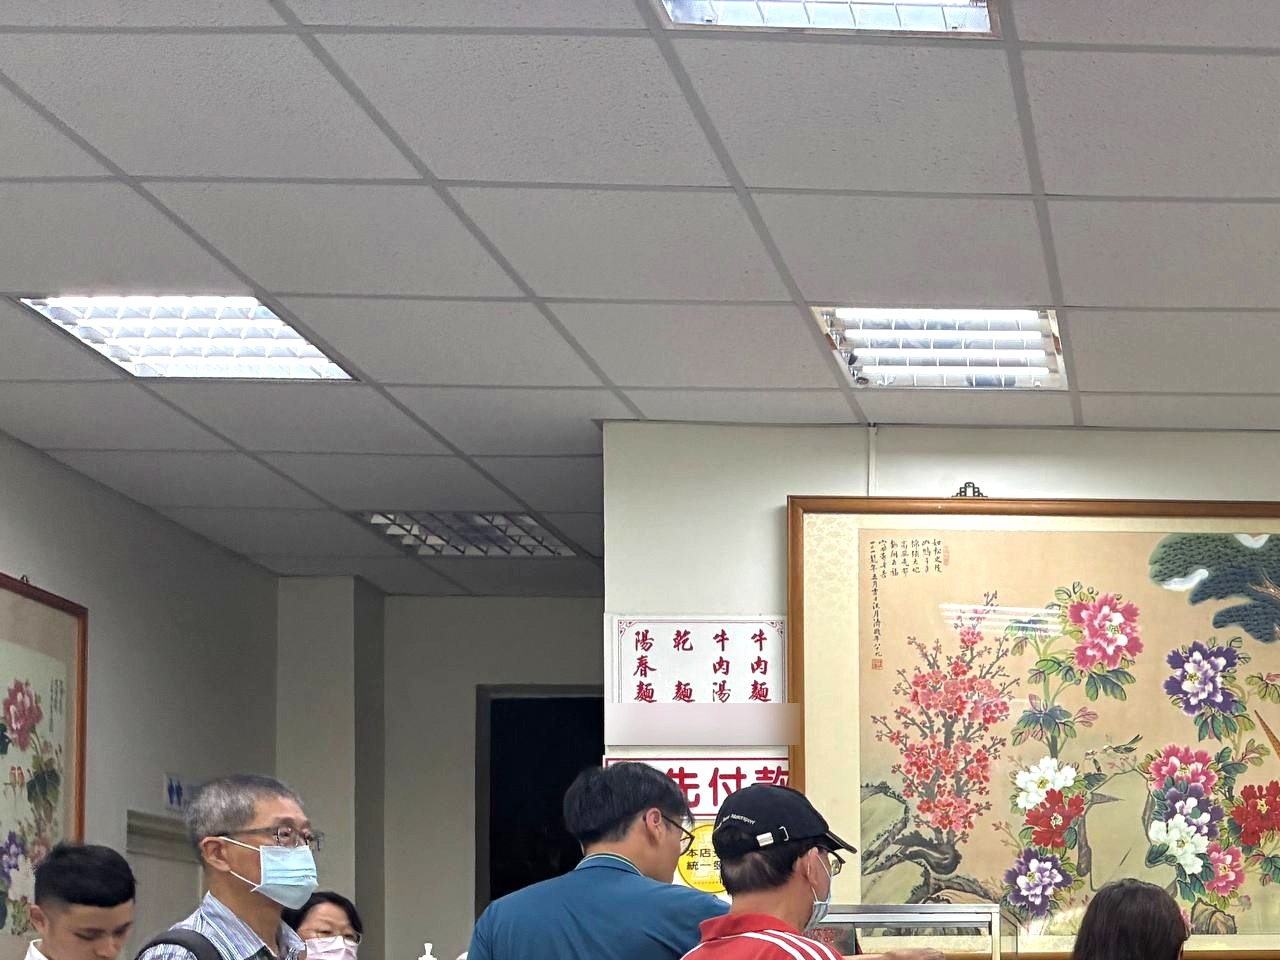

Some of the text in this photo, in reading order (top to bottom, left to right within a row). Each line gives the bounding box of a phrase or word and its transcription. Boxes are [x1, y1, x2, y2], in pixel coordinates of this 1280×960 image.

[632, 629, 658, 703] 陽春麵
[672, 629, 696, 703] 乾麵
[712, 628, 732, 703] 牛肉湯
[748, 628, 772, 703] 牛肉麵
